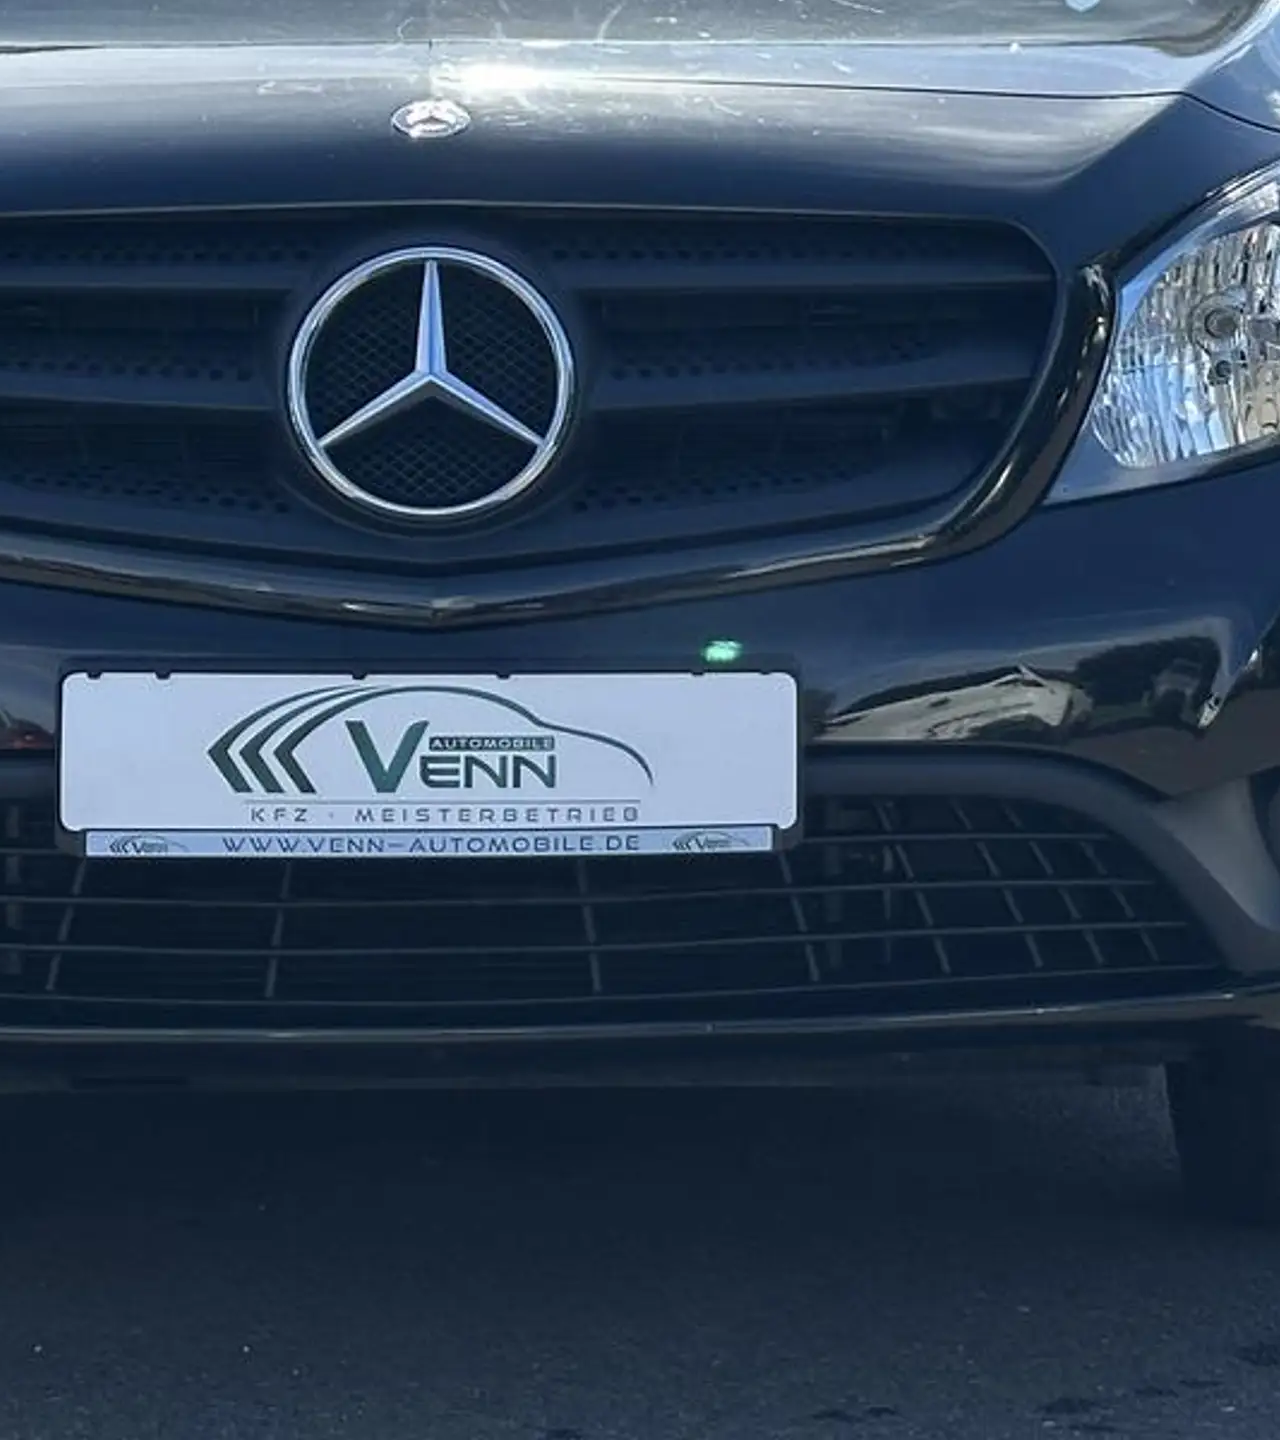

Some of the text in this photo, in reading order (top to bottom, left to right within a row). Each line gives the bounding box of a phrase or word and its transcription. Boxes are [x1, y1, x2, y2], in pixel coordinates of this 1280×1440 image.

[430, 738, 553, 750] AUTOMOBILE
[344, 720, 556, 793] VENN
[250, 807, 308, 823] KFZ
[354, 807, 639, 823] MEISTERBETRIEB
[221, 835, 641, 854] WWW.VENN-AUTOMOBILE.DE
